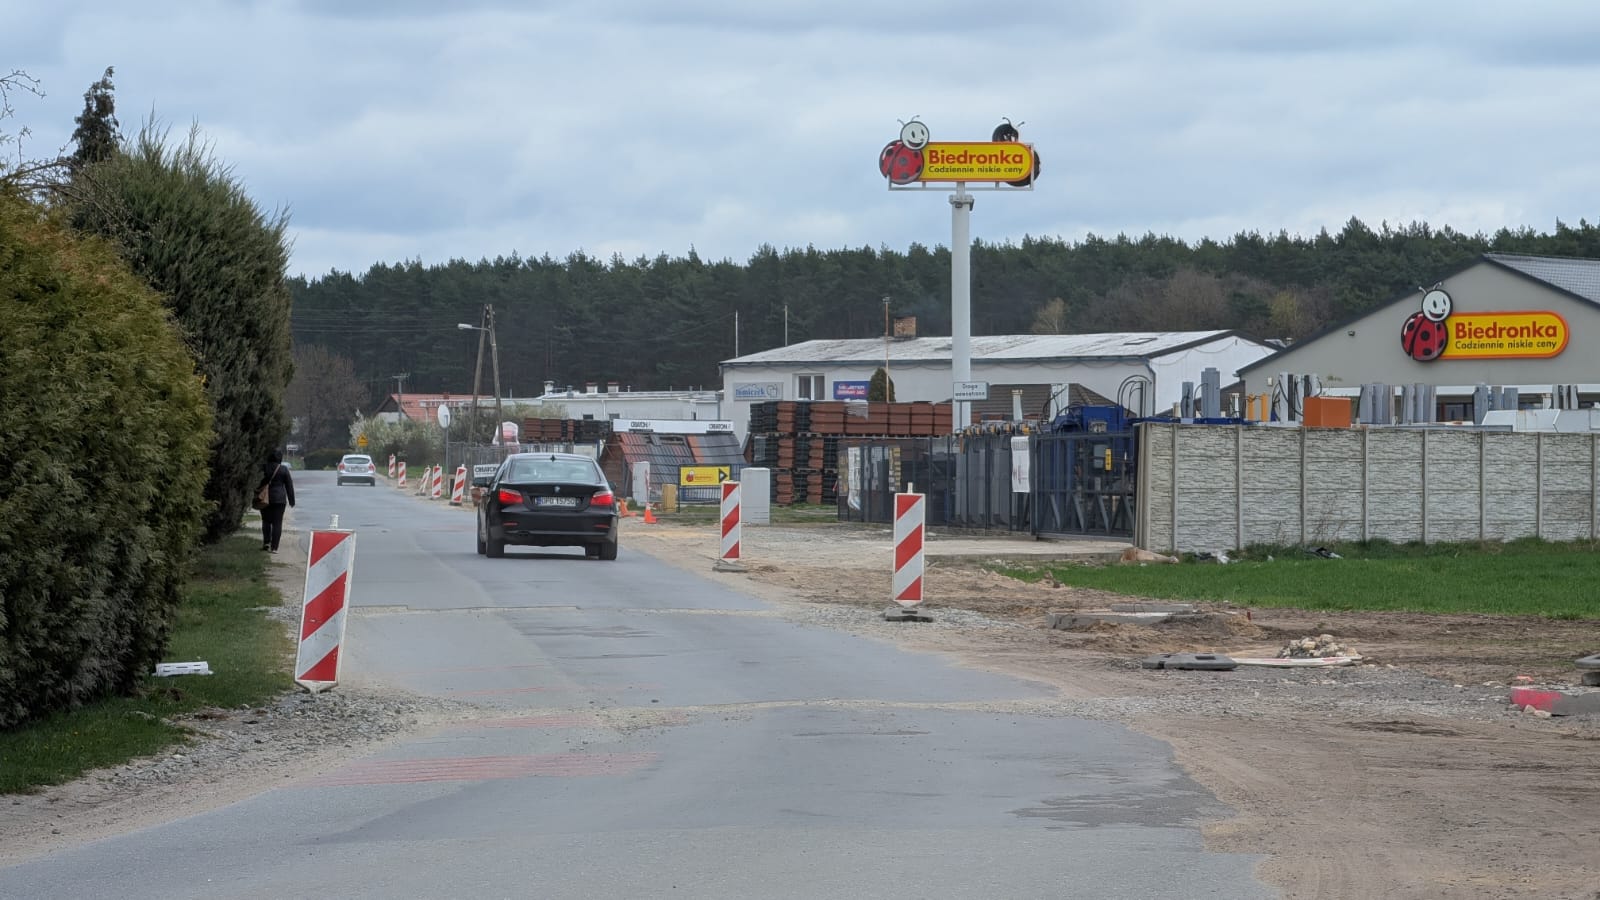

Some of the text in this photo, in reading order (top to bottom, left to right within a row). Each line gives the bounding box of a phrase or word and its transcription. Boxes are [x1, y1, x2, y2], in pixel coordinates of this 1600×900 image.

[929, 150, 1023, 164] Biedronka
[929, 165, 1023, 174] Codziennie niskie ceny
[1455, 321, 1557, 339] Biedronka
[1455, 340, 1557, 350] Codziennie niskie ceny
